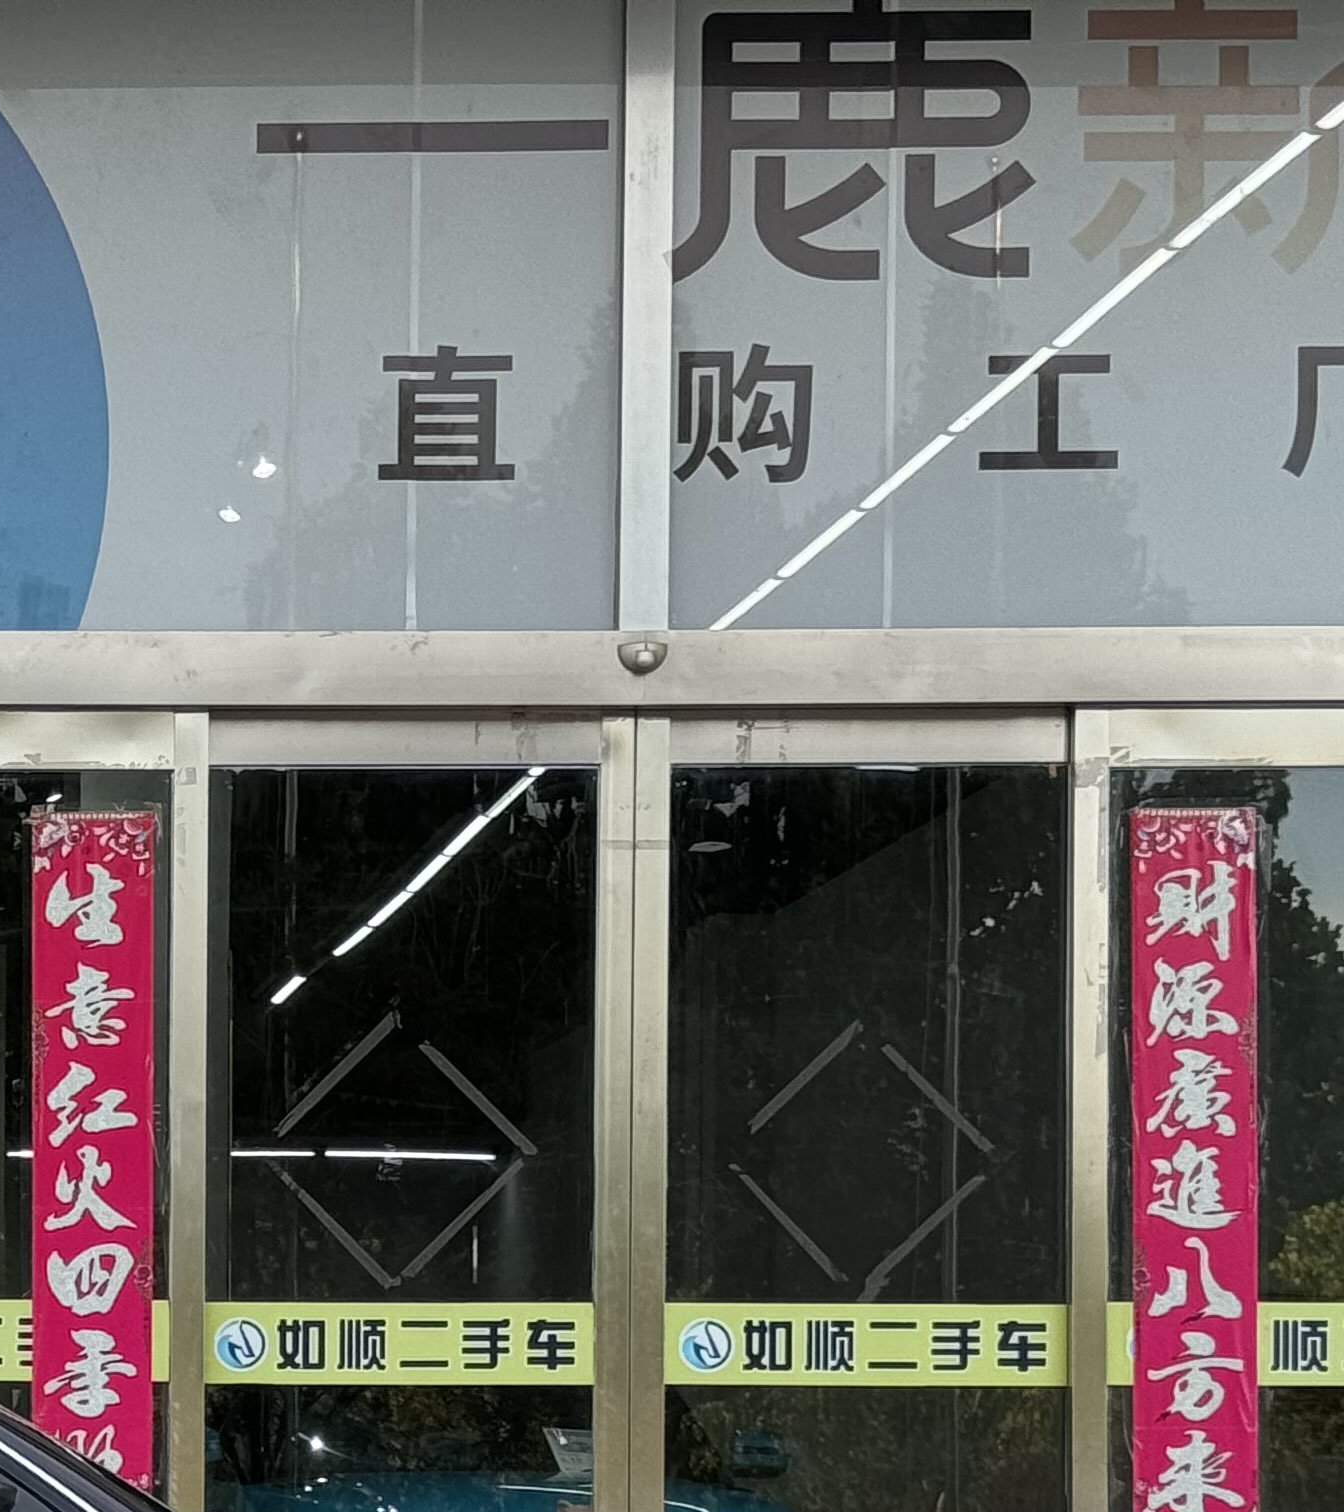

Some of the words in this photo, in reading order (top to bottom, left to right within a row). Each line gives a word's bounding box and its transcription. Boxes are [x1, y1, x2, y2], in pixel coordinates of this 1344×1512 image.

[276, 1318, 577, 1370] 如顺二手车
[742, 1319, 1048, 1372] 如顺二手车
[1270, 1319, 1329, 1372] 顺
